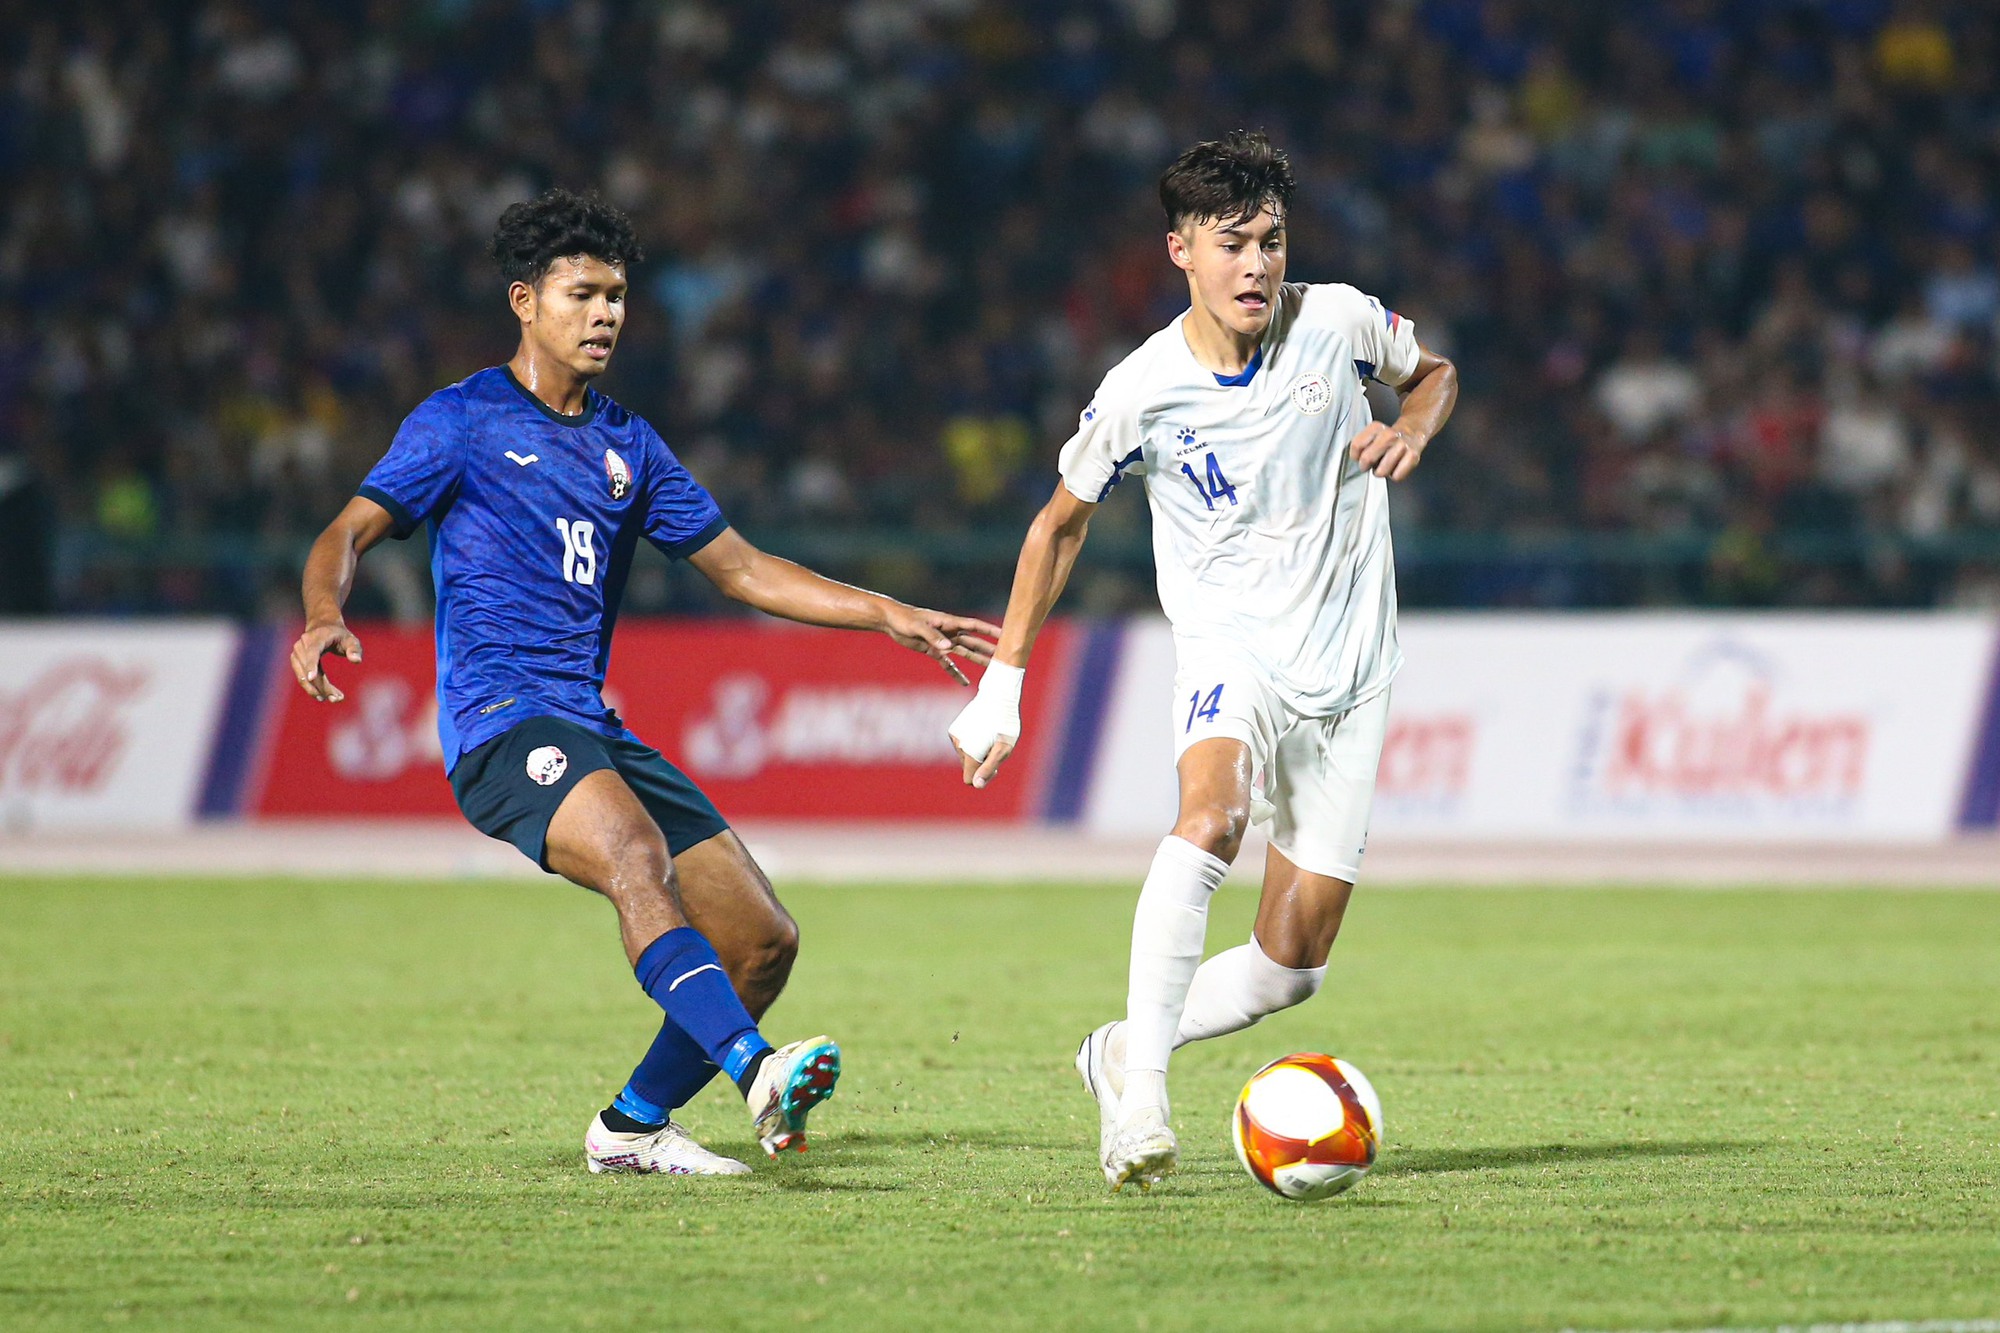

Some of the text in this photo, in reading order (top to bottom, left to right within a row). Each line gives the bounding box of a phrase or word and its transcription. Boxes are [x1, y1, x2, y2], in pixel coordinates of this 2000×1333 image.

[1176, 442, 1209, 457] KELME
[1181, 452, 1238, 511] 14
[556, 518, 596, 586] 19
[1185, 683, 1225, 734] 14
